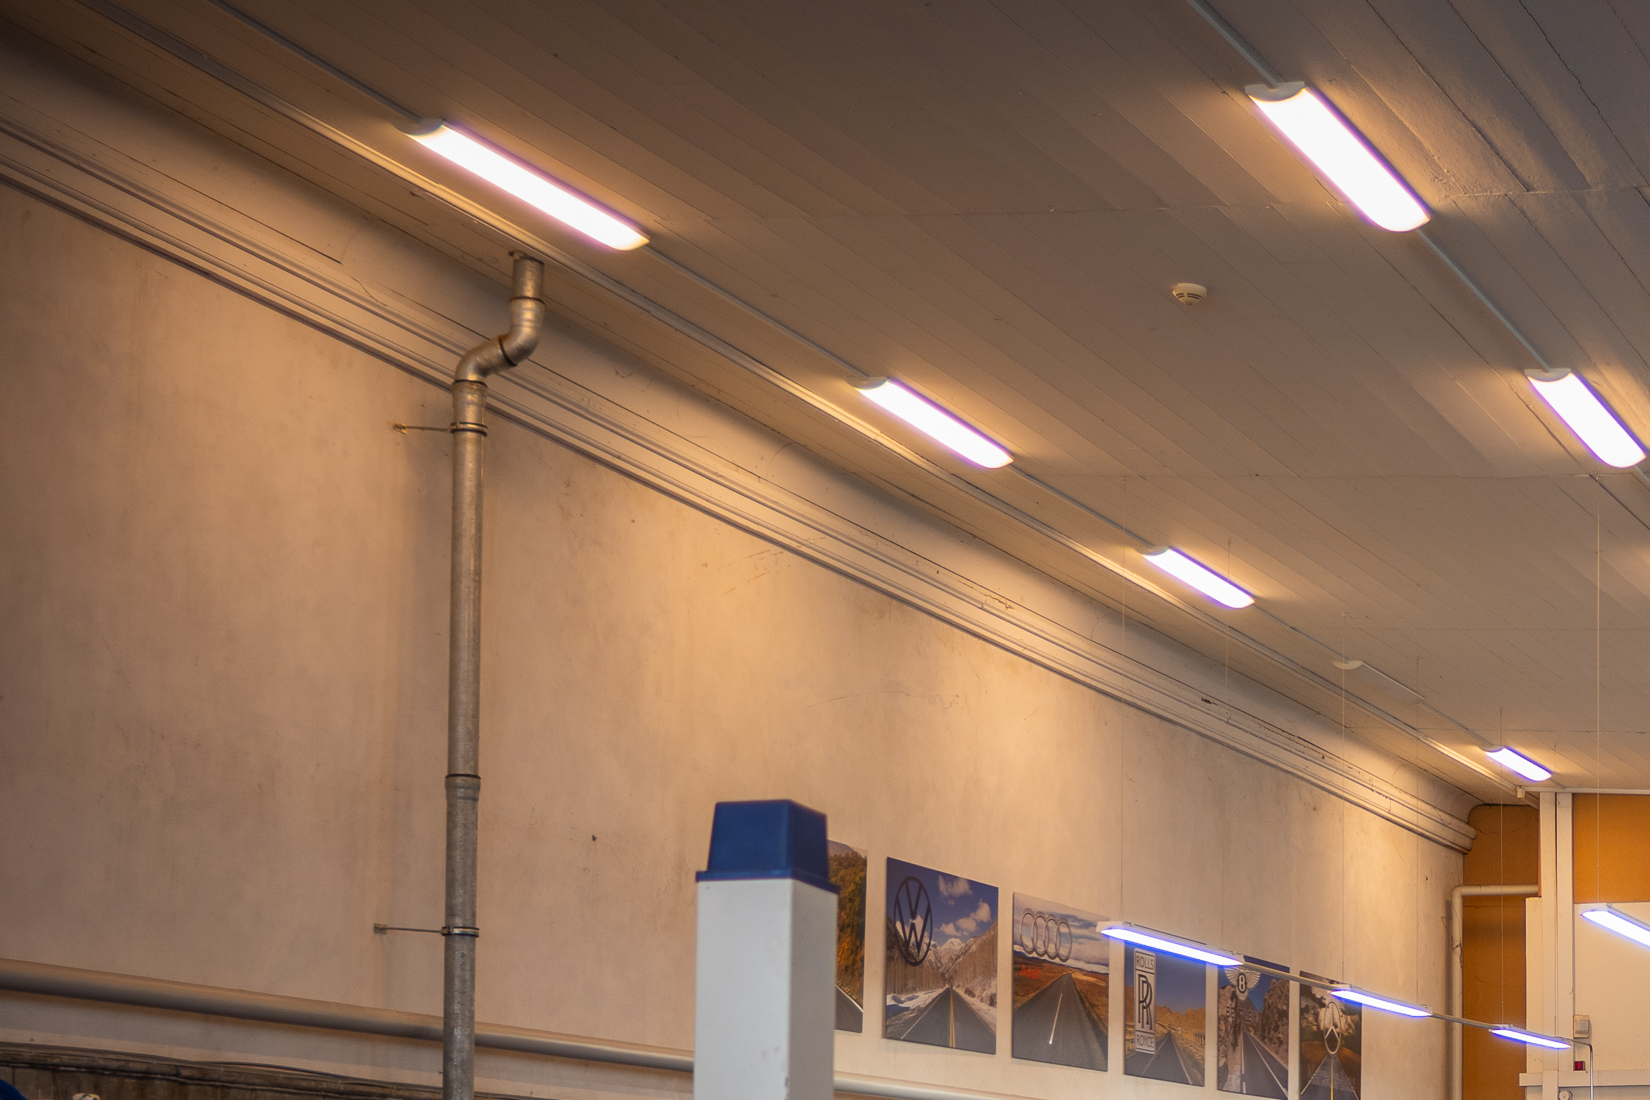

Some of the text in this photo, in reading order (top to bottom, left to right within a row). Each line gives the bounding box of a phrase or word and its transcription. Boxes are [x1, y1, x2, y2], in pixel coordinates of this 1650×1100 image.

[1136, 957, 1154, 971] ROLLS
[1021, 965, 1040, 980] Audi
[1136, 1034, 1154, 1049] ROYCE
